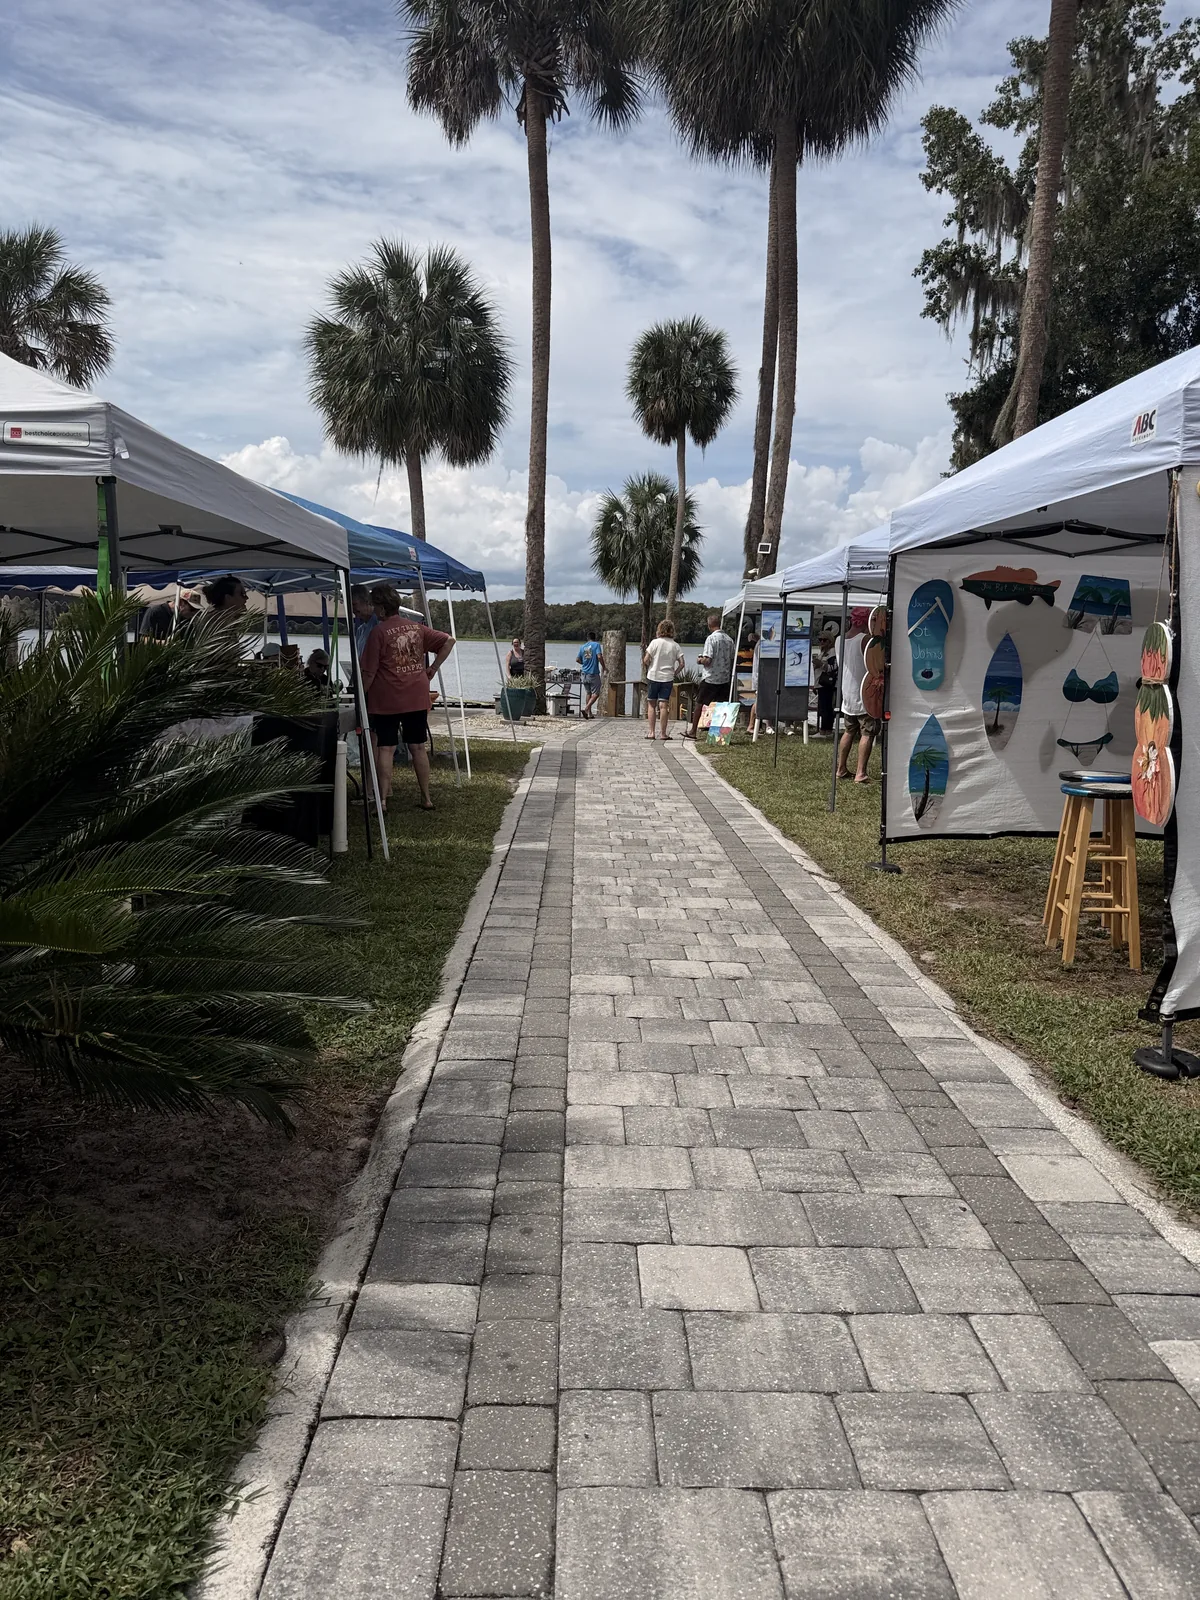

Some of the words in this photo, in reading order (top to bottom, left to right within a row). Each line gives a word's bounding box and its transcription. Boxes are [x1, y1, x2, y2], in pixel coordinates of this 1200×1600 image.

[1133, 409, 1157, 436] ABC
[25, 430, 82, 438] bestchoiceproducts
[386, 626, 401, 636] HEY
